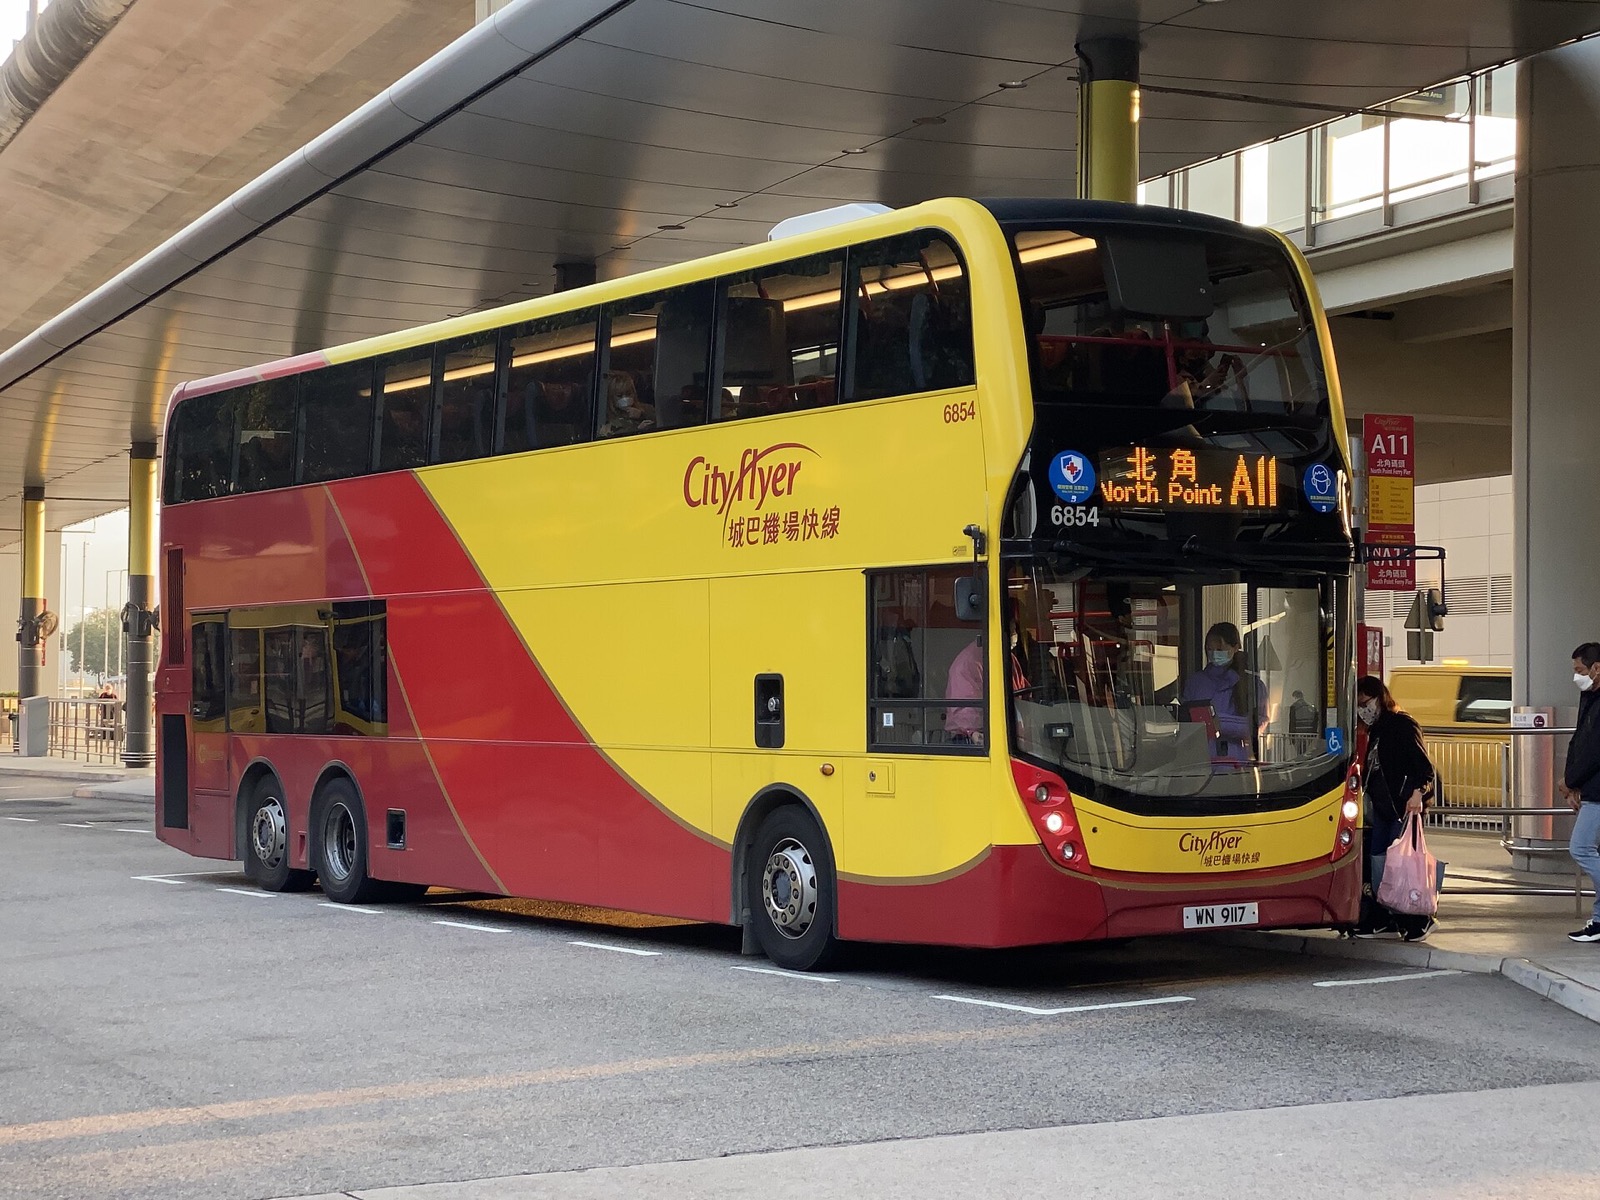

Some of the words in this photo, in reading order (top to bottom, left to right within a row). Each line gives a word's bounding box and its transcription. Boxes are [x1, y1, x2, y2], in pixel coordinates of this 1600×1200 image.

[943, 400, 976, 423] 6854
[1371, 434, 1408, 455] A11
[683, 444, 806, 515] Cityflyer
[1230, 454, 1277, 506] A11
[1100, 481, 1159, 503] North
[1168, 483, 1222, 504] Point
[728, 505, 841, 549] 城巴機場快線
[1051, 505, 1099, 527] 6854
[1179, 830, 1244, 855] Cityflyer
[1203, 852, 1260, 867] 城巴機場快線
[1195, 908, 1215, 925] WN
[1221, 906, 1247, 923] 9117
